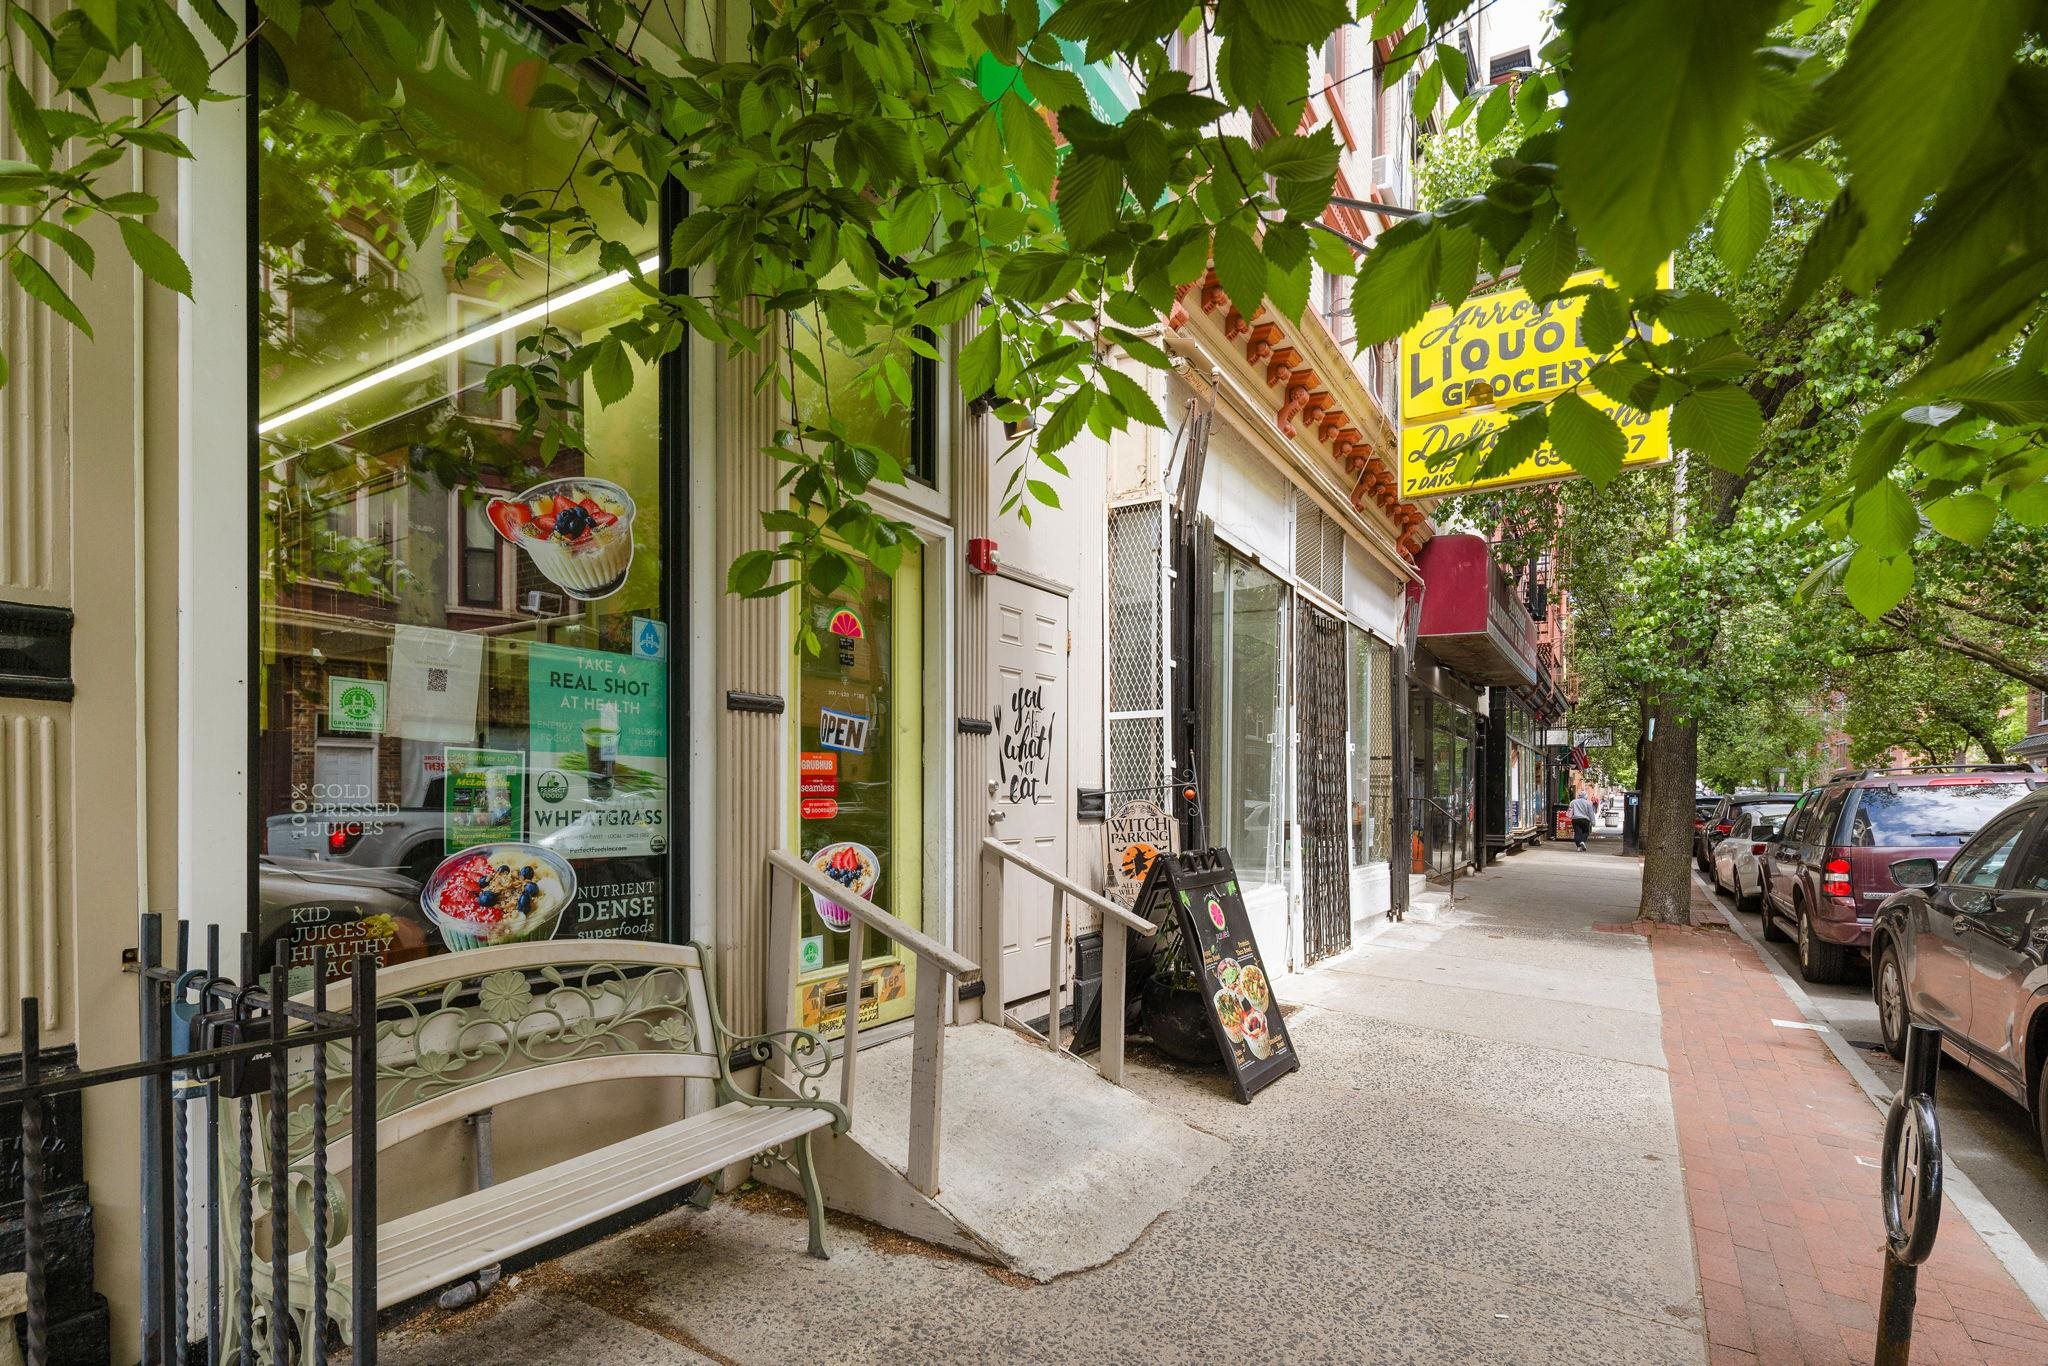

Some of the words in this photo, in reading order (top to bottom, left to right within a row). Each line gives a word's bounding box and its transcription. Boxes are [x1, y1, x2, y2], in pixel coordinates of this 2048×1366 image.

[1406, 478, 1417, 493] 7
[1418, 472, 1454, 490] DAYS
[577, 656, 613, 673] TAKE
[617, 664, 626, 674] A
[550, 671, 597, 692] REAL
[604, 678, 649, 697] SHOT
[560, 696, 579, 709] AT
[584, 698, 640, 715] HEALTH
[1011, 685, 1045, 735] you
[820, 713, 864, 749] OPEN
[1004, 724, 1047, 763] what
[801, 759, 833, 770] GRUBHUB
[311, 783, 370, 799] COLD
[800, 783, 835, 792] seamless
[1009, 774, 1040, 806] eat
[310, 802, 400, 818] PRESSED
[534, 809, 663, 827] WHEATGRASS
[310, 821, 384, 837] JUICES
[1110, 817, 1167, 833] WITCH
[1110, 830, 1169, 844] PARKING
[577, 881, 655, 900] NUTRIENT
[1118, 888, 1135, 896] WILL
[290, 906, 331, 924] KID
[577, 896, 655, 923] DENSE
[290, 921, 367, 943] JUICES
[577, 919, 655, 939] superfoods
